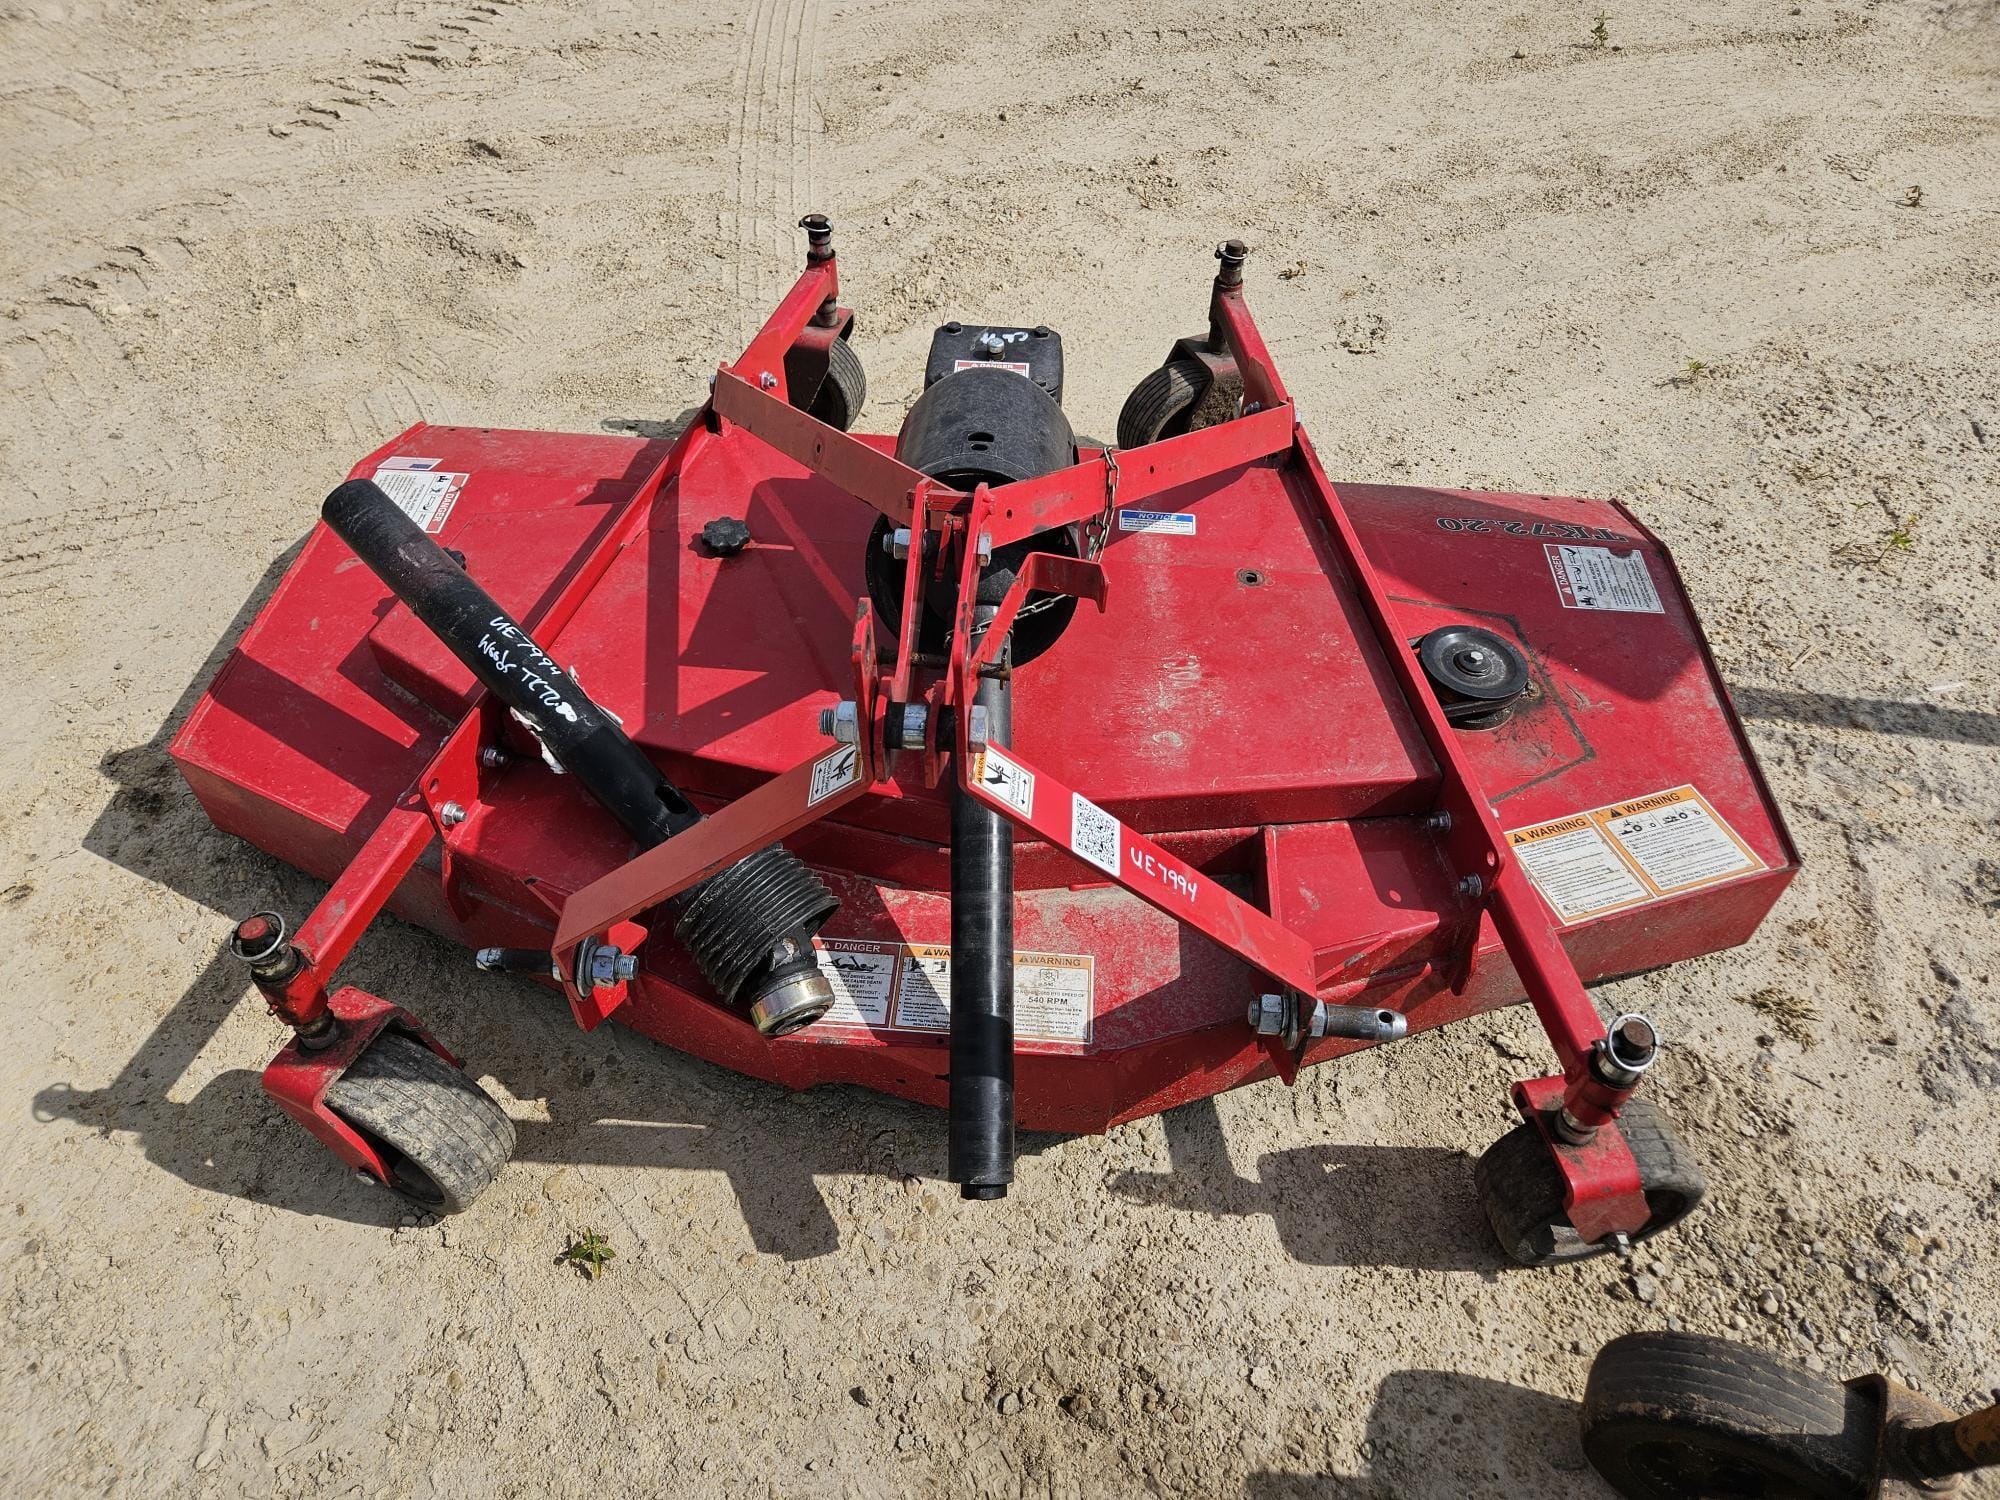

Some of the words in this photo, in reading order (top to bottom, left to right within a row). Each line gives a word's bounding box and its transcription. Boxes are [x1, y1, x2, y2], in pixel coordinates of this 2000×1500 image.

[434, 493, 455, 521] DANGER
[1138, 513, 1178, 521] NOTICE
[1436, 517, 1630, 543] TK72.20
[1551, 555, 1567, 586] DANGER
[489, 616, 561, 675] UE7994
[1623, 792, 1681, 815] WARNING
[1527, 817, 1587, 840] WARNING
[1130, 847, 1198, 903] UE7994
[834, 942, 881, 953] DANGER
[1030, 955, 1081, 967] WARNING
[1028, 996, 1044, 1004] 540
[1046, 997, 1068, 1005] RPM
